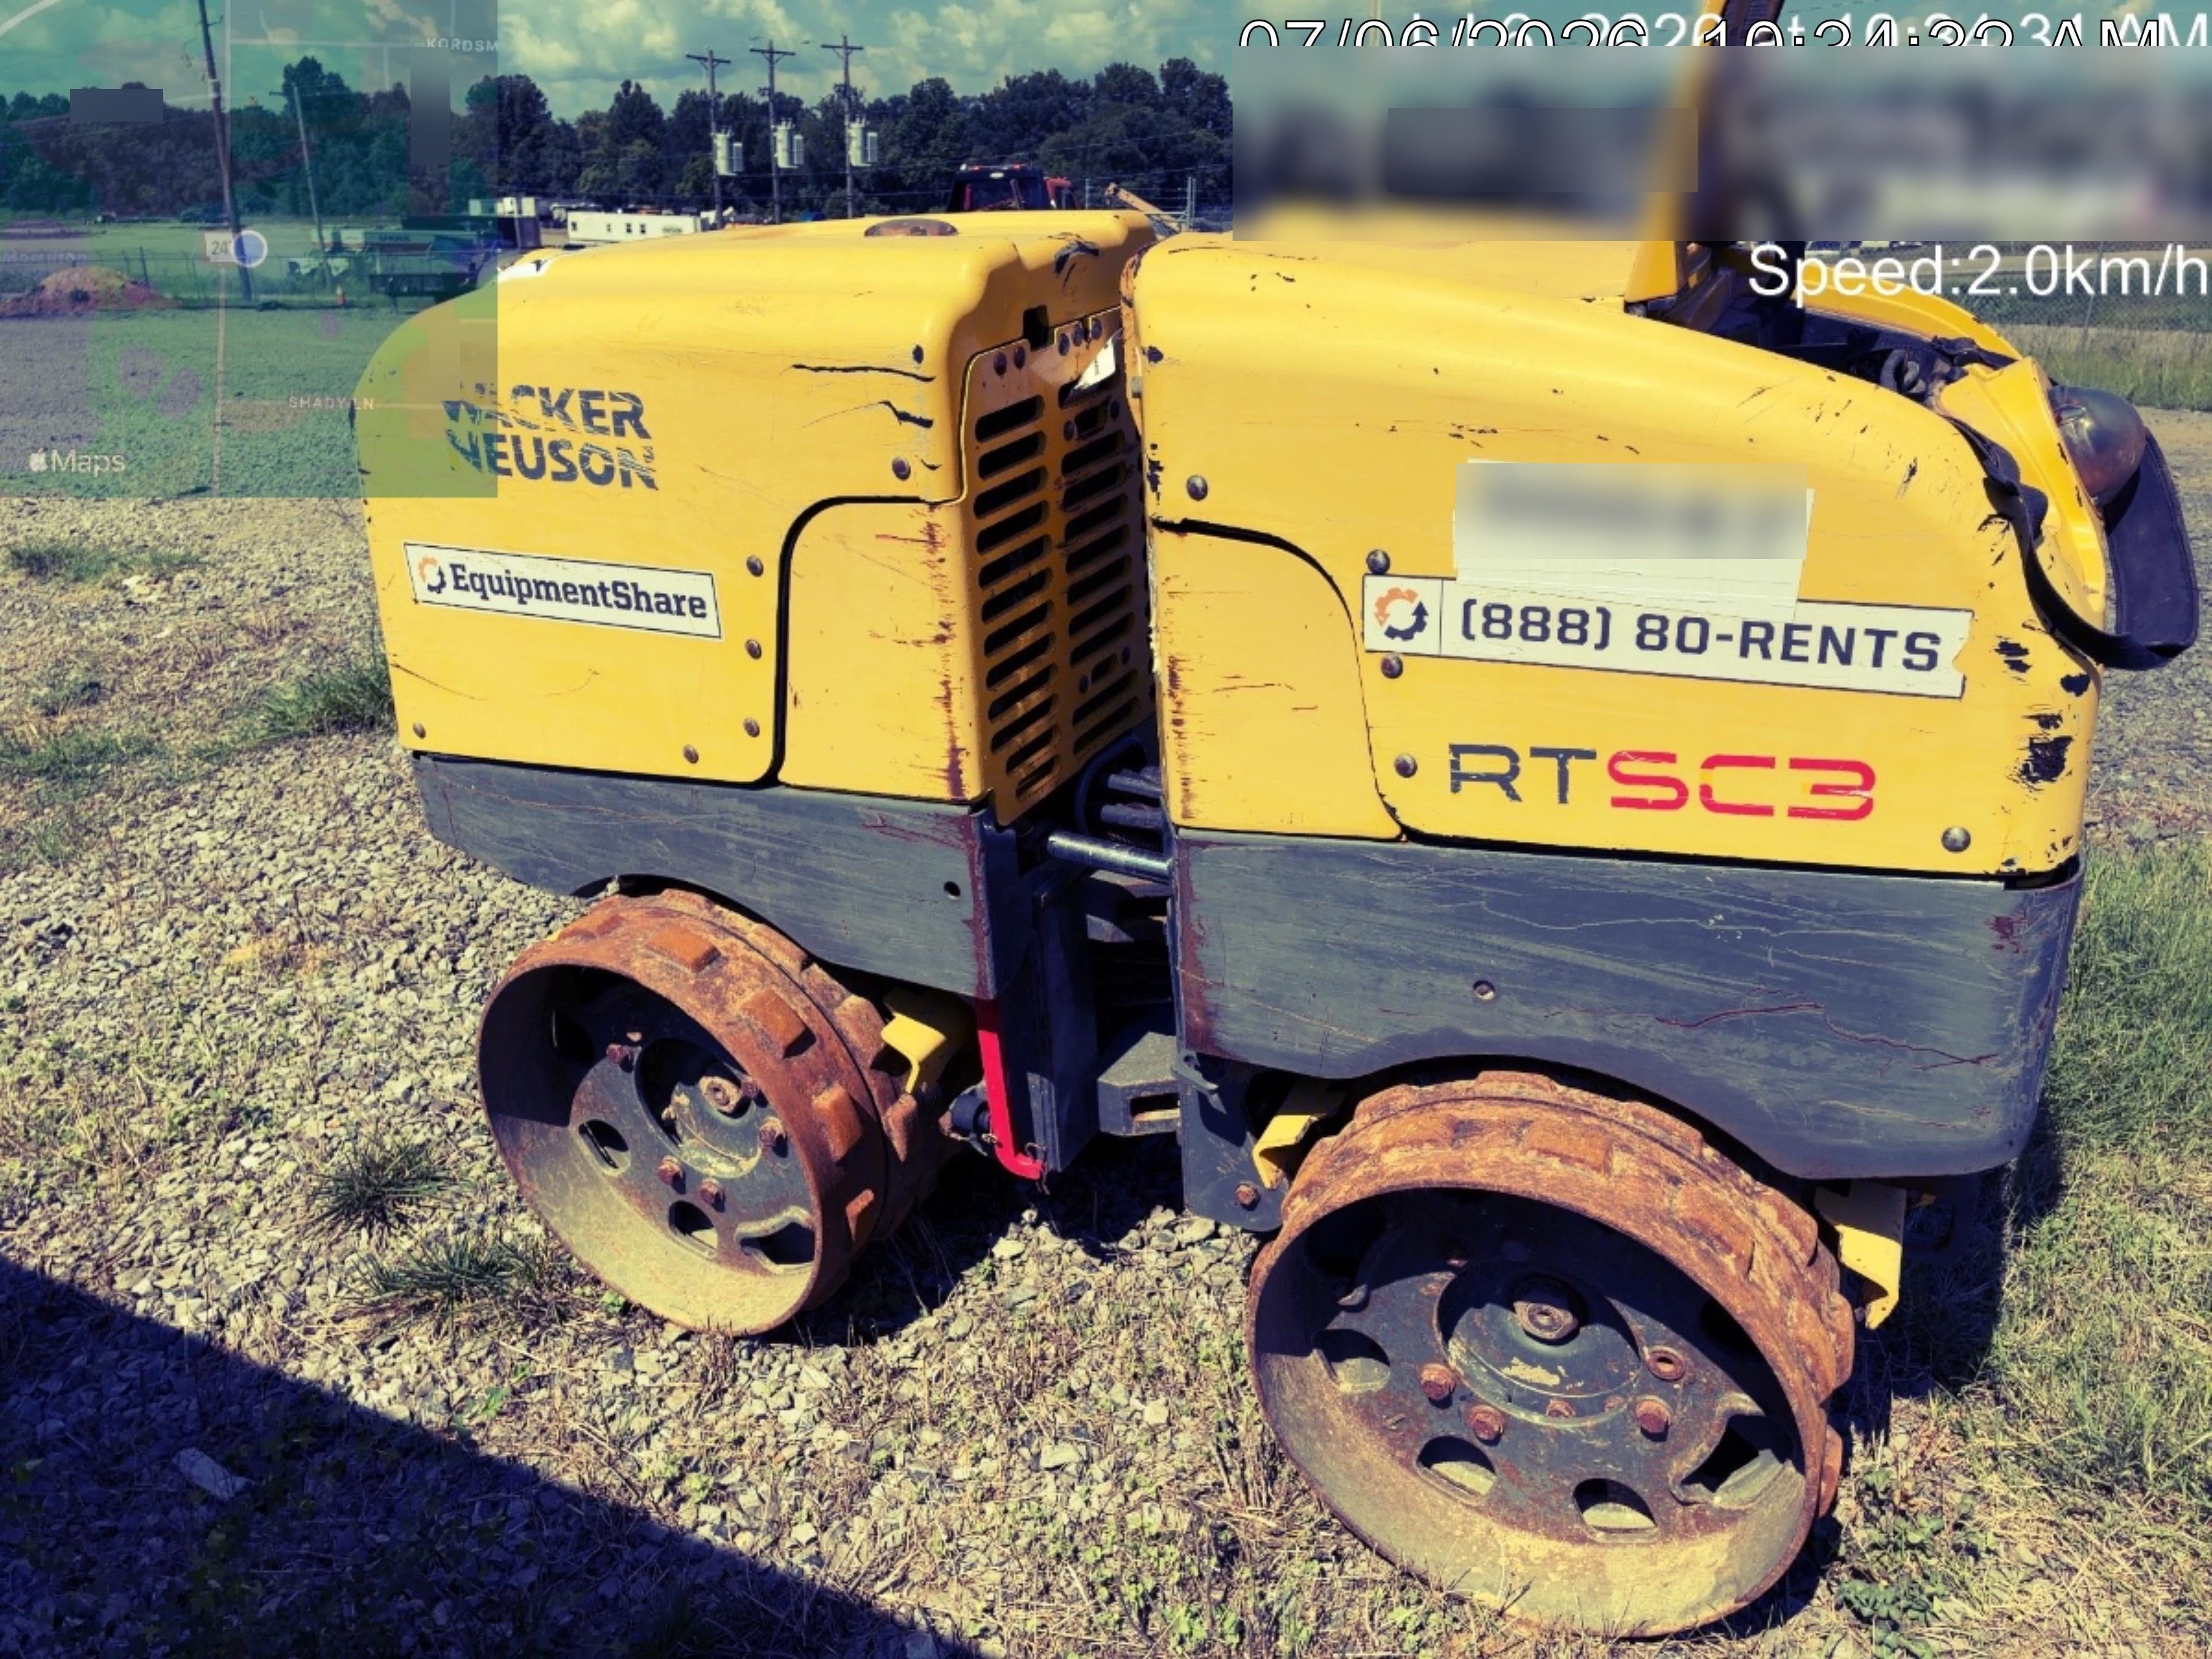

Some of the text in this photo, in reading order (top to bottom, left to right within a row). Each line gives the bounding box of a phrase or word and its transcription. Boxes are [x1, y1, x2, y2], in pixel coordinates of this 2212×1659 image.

[442, 382, 652, 439] WCKER
[449, 563, 707, 619] EquipmentShare
[1461, 598, 1942, 672] (888) 80-RENTS
